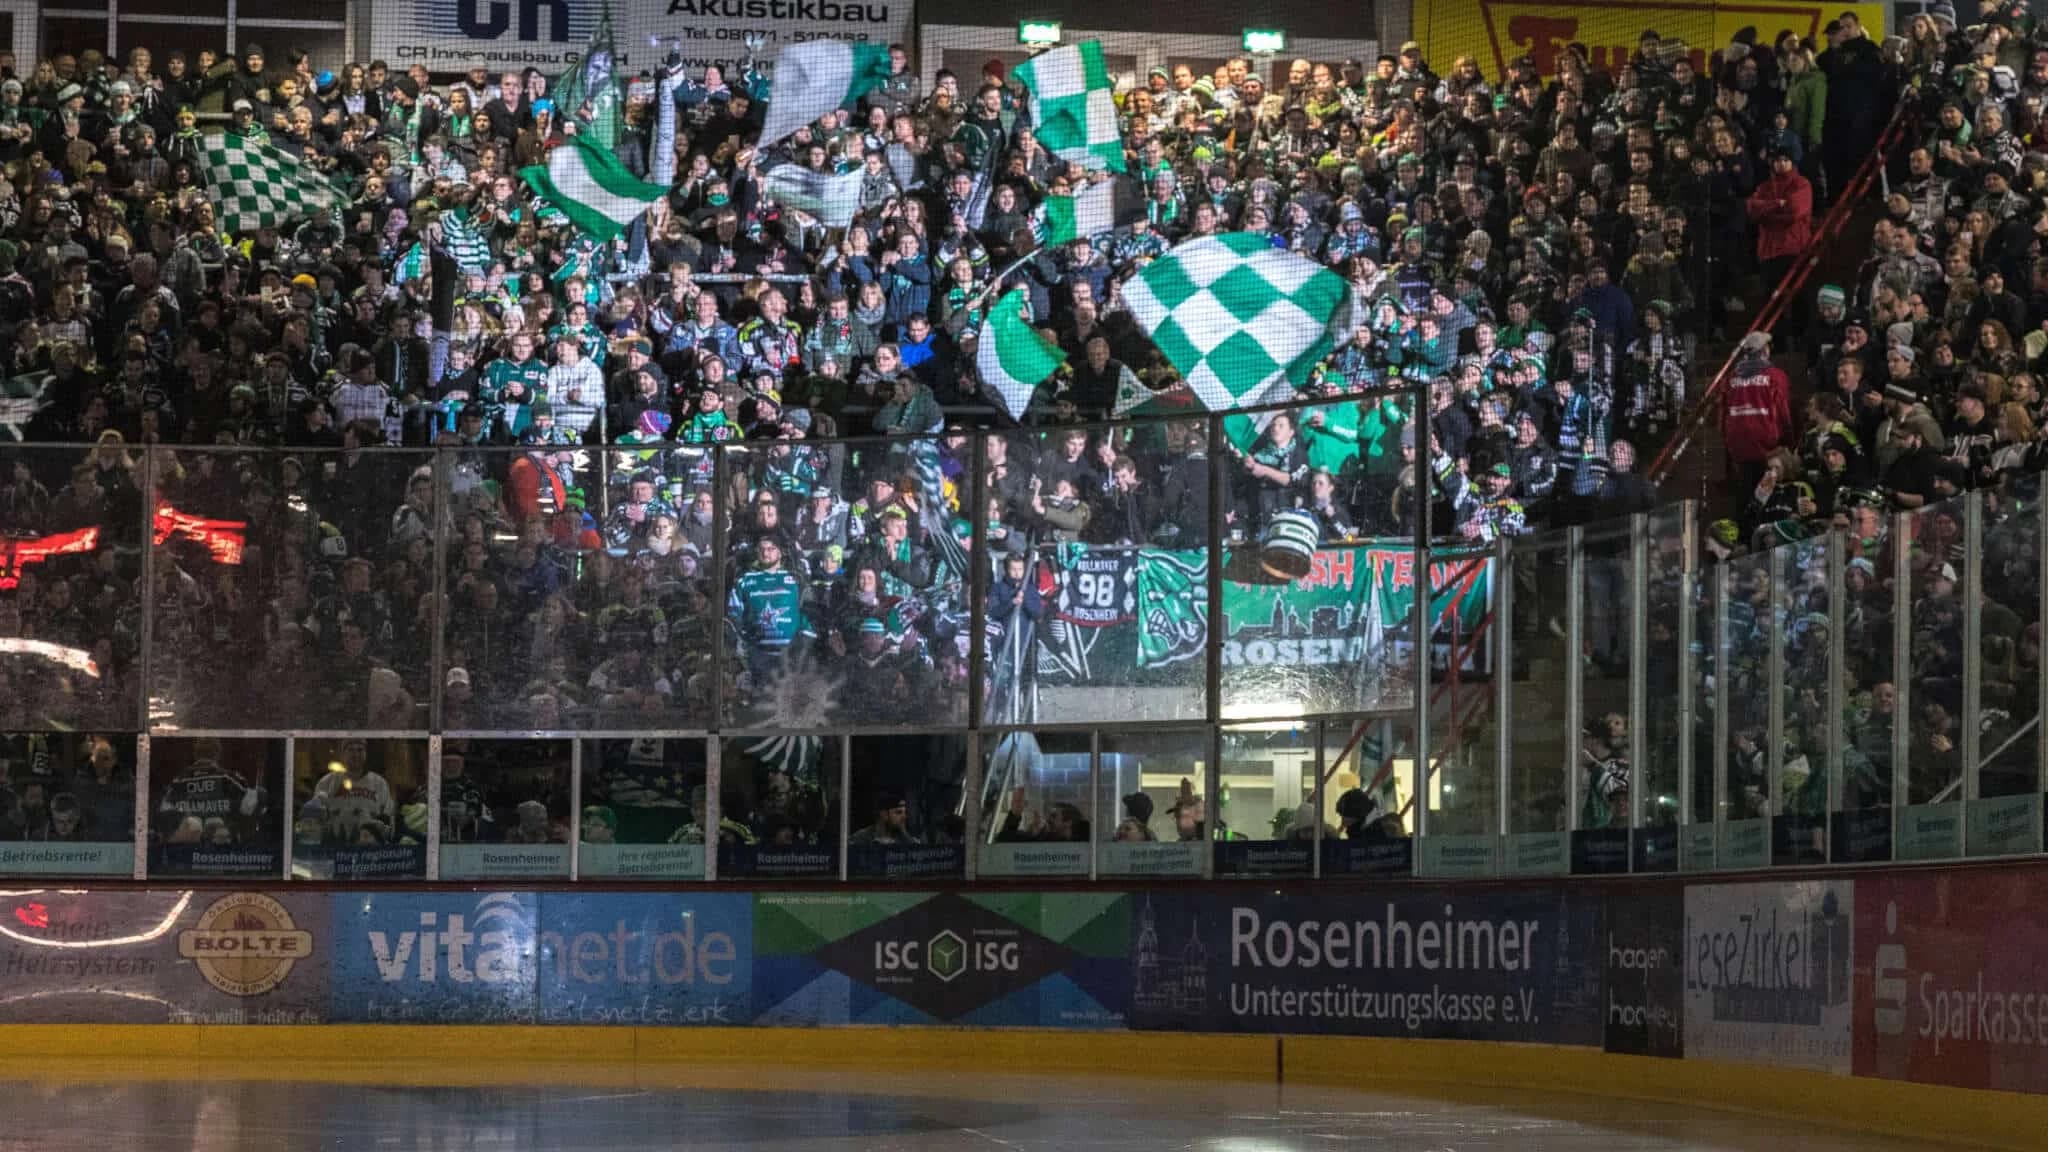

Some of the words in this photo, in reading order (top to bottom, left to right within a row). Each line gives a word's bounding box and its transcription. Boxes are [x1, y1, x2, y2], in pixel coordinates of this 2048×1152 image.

[666, 0, 889, 23] Akustikbau
[683, 27, 710, 40] Tel.
[396, 46, 426, 58] CR
[432, 47, 558, 63] Innenausbau
[564, 54, 628, 66] GH
[1078, 573, 1115, 608] 98
[192, 852, 274, 864] Rosenheimer
[483, 852, 561, 864] Rosenheimer
[757, 852, 831, 864] Rosenheimer
[368, 910, 737, 985] vitanet.de
[1231, 903, 1539, 971] Rosenheimer
[875, 941, 919, 970] ISC
[975, 941, 1019, 971] ISG
[1609, 930, 1668, 984] hager
[1231, 983, 1496, 1029] Unterstützungskasse
[1502, 988, 1539, 1024] e.V.
[1919, 968, 2048, 1056] Sparkasse
